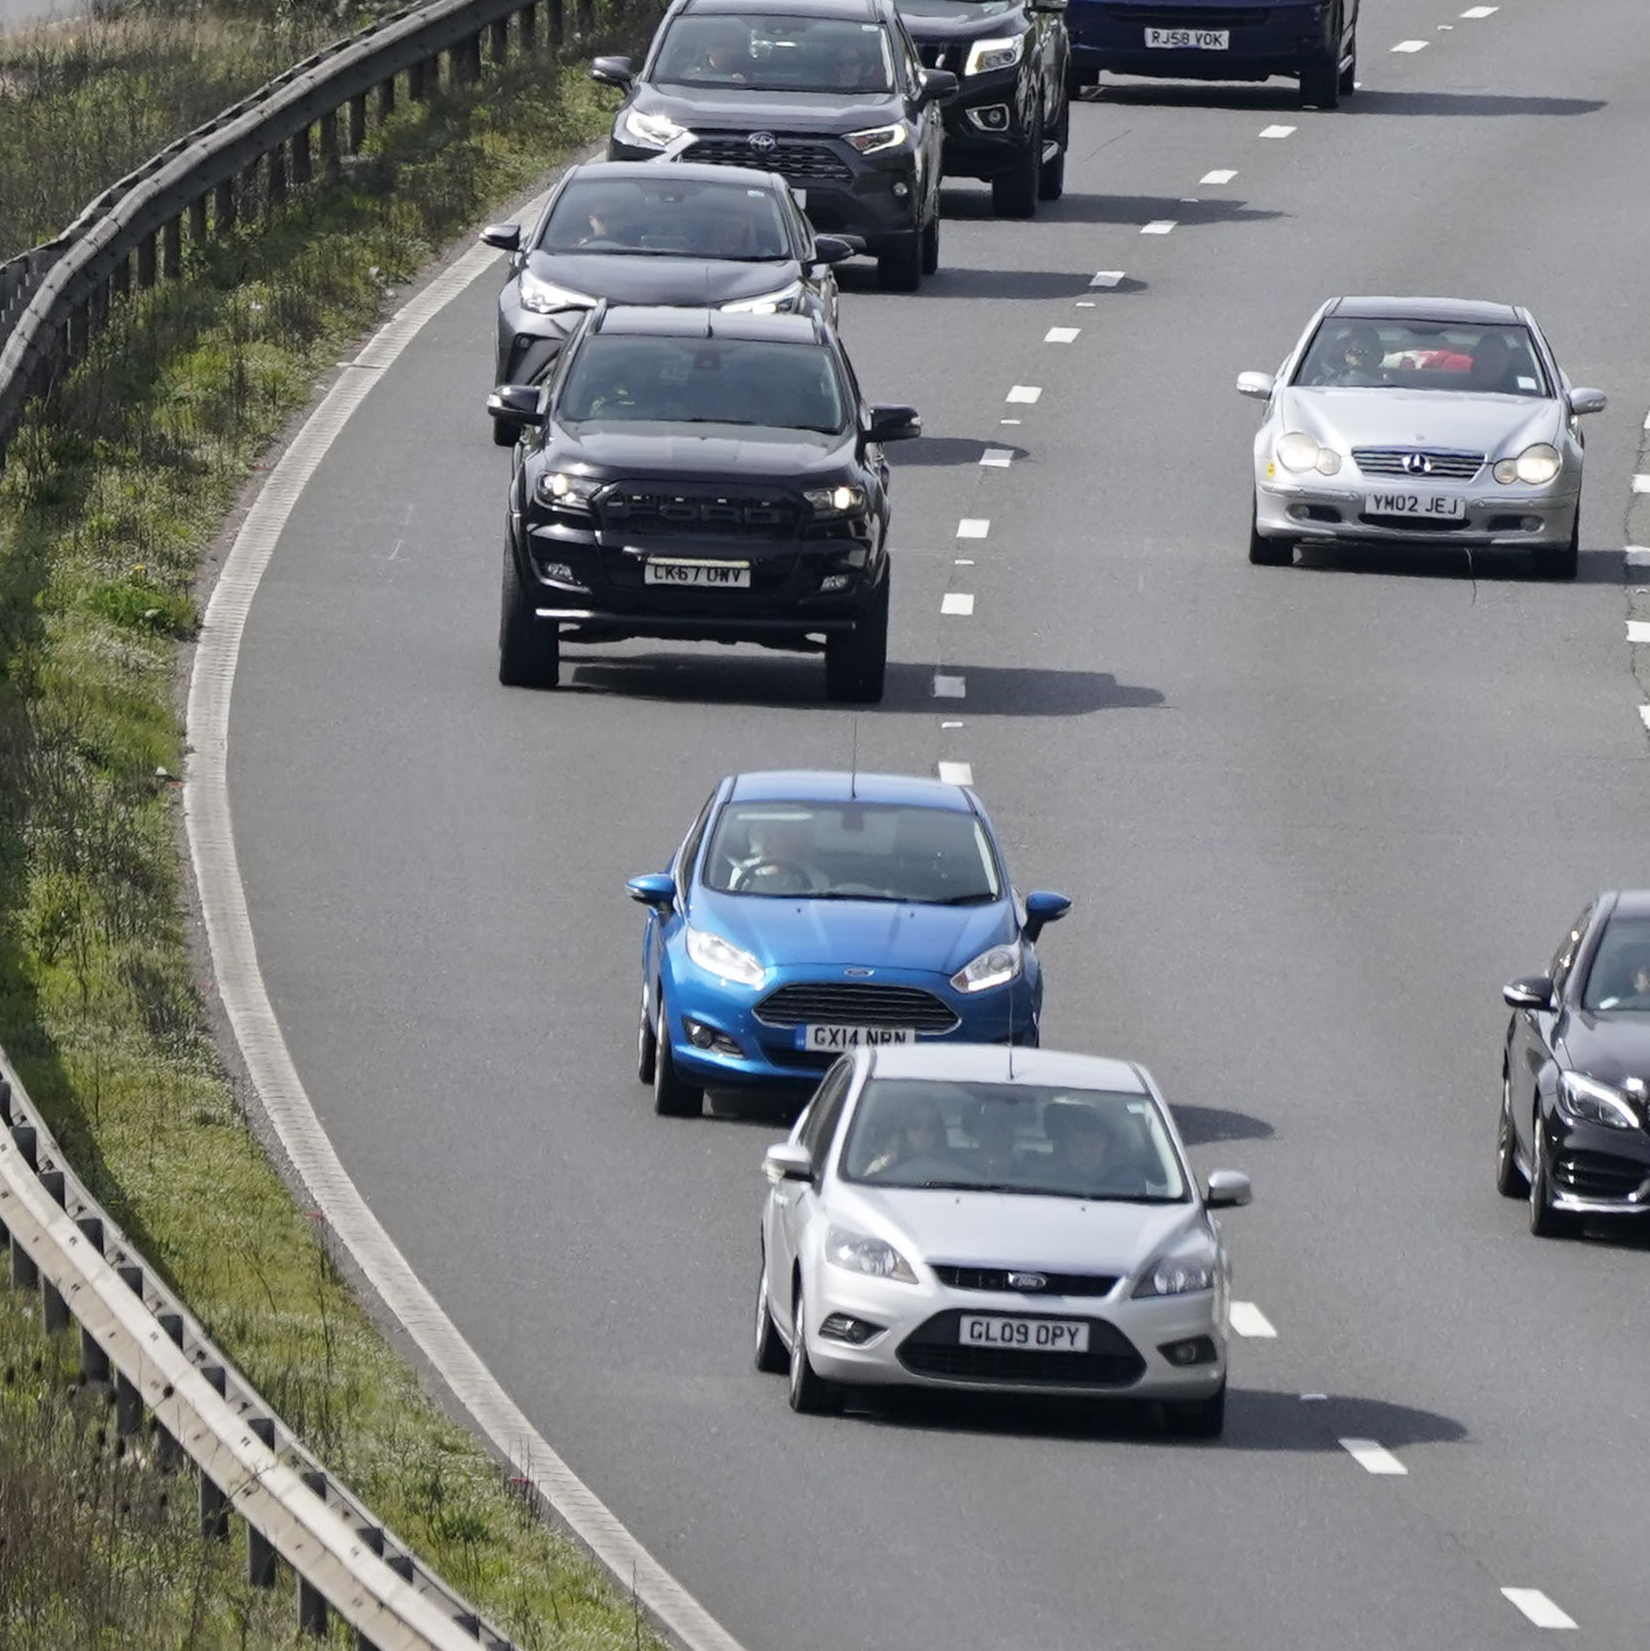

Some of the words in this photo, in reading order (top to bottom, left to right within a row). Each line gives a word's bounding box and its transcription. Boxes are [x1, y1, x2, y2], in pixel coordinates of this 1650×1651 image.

[1151, 30, 1190, 45] RJ58
[1373, 494, 1418, 513] YM02
[1425, 496, 1459, 516] JEJ
[813, 1026, 859, 1048] GX14
[969, 1319, 1029, 1344] GL09
[1035, 1323, 1080, 1348] OPY
